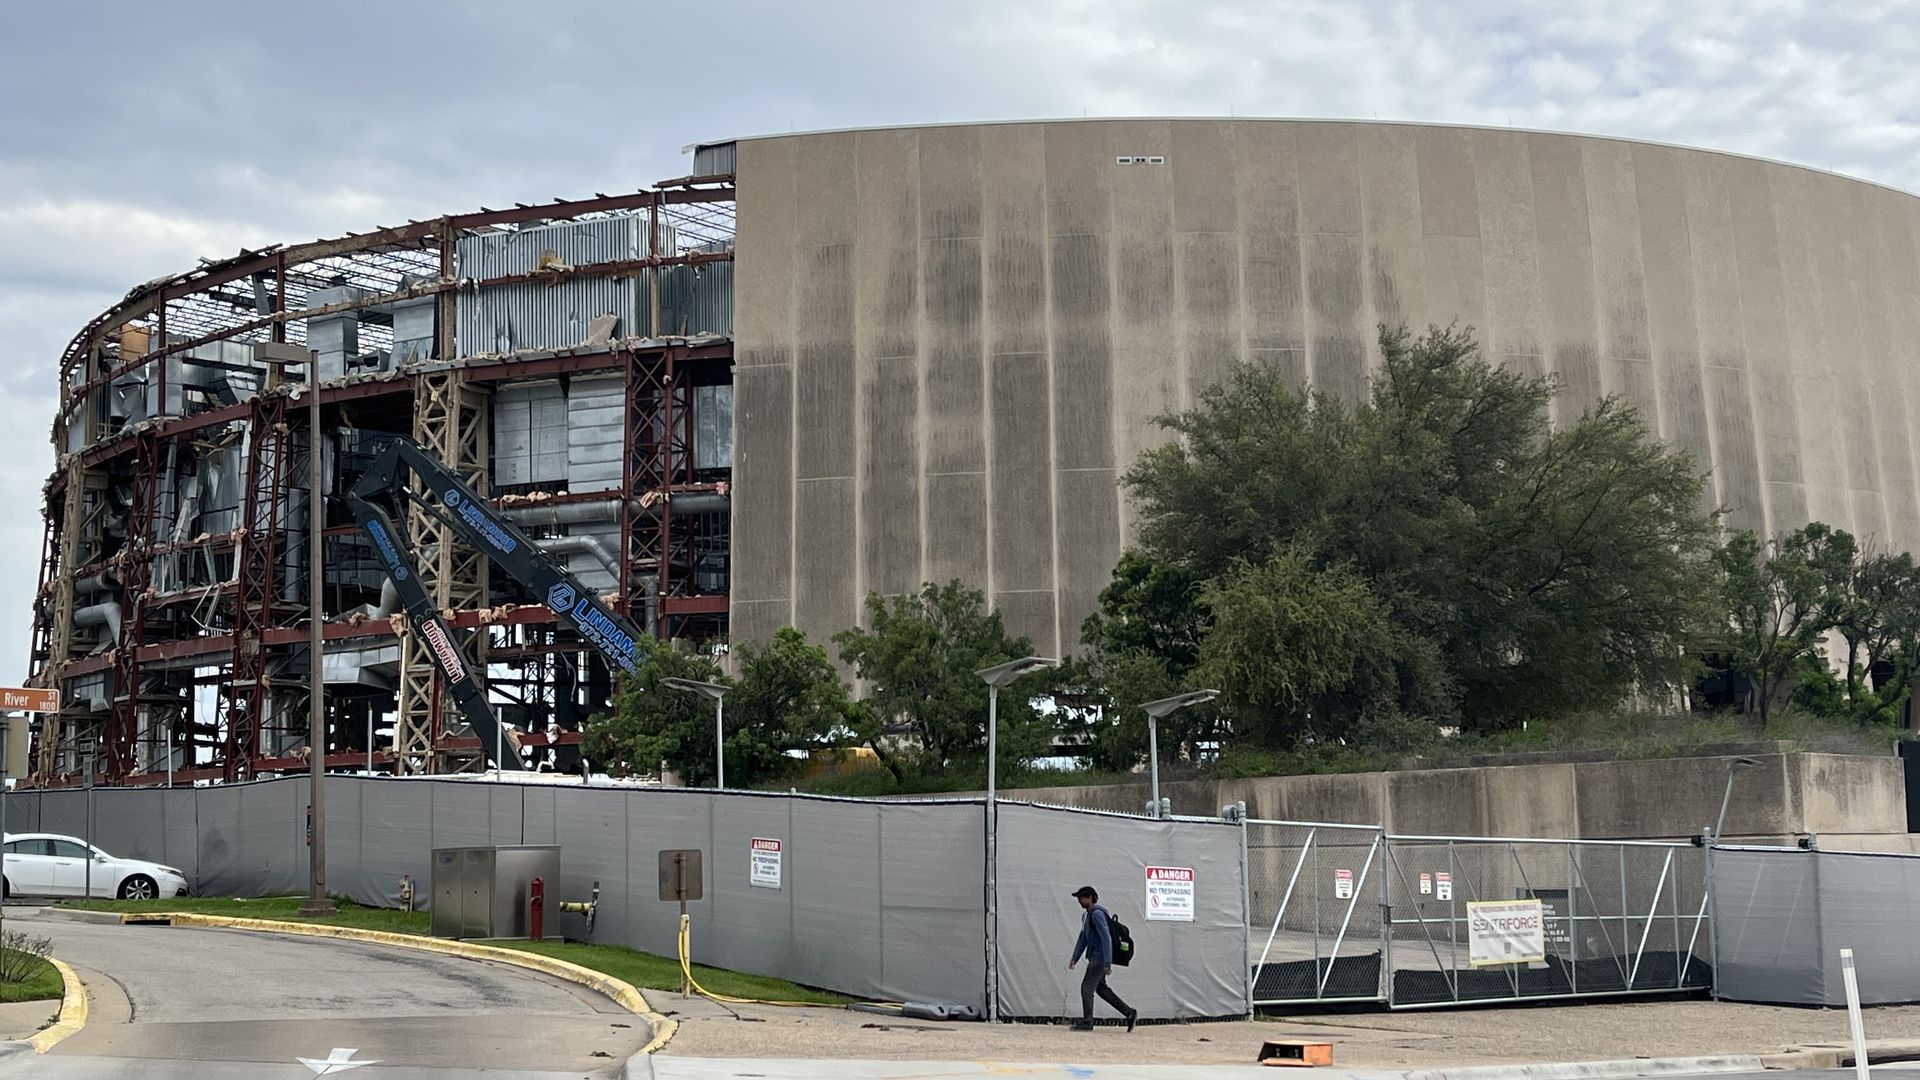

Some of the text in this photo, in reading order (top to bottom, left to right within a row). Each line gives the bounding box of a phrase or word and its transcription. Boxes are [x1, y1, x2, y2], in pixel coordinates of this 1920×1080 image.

[422, 620, 464, 683] LINDAMOOD
[4, 691, 56, 706] River ST
[40, 701, 56, 711] 1800
[1158, 869, 1190, 881] DANGER
[1158, 888, 1191, 896] TRESPASSING
